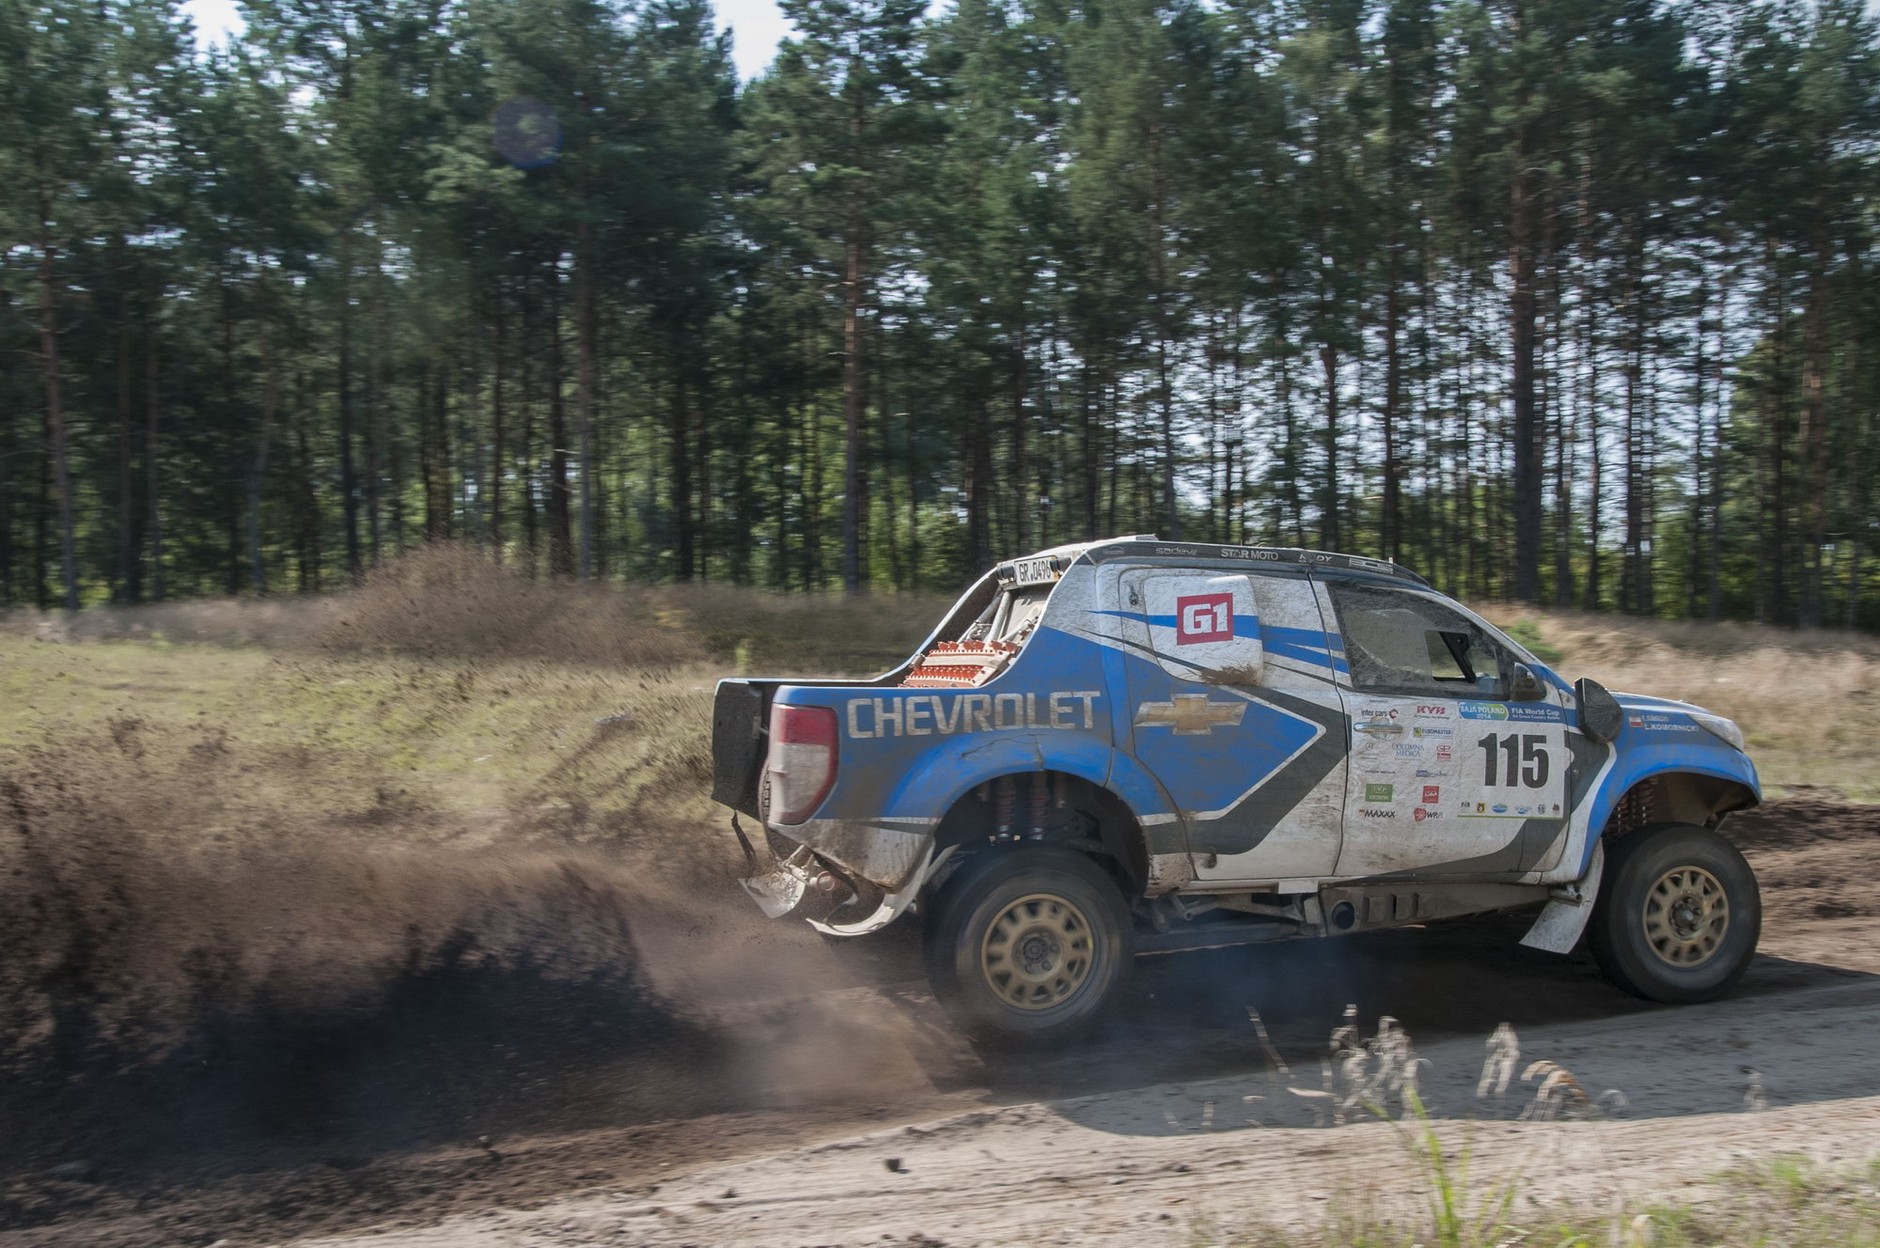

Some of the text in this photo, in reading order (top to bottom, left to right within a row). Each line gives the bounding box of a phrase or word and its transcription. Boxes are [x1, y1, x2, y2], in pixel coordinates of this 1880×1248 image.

[1221, 548, 1279, 561] STAR MOTO
[1183, 602, 1228, 635] G1
[1375, 709, 1388, 717] cars
[1460, 705, 1505, 714] BAJA POLAND
[1546, 709, 1559, 717] Cup
[847, 691, 1100, 739] CHEVROLET
[1391, 743, 1425, 752] COLUMNA
[1478, 733, 1549, 789] 115
[1364, 809, 1395, 818] MAXXX
